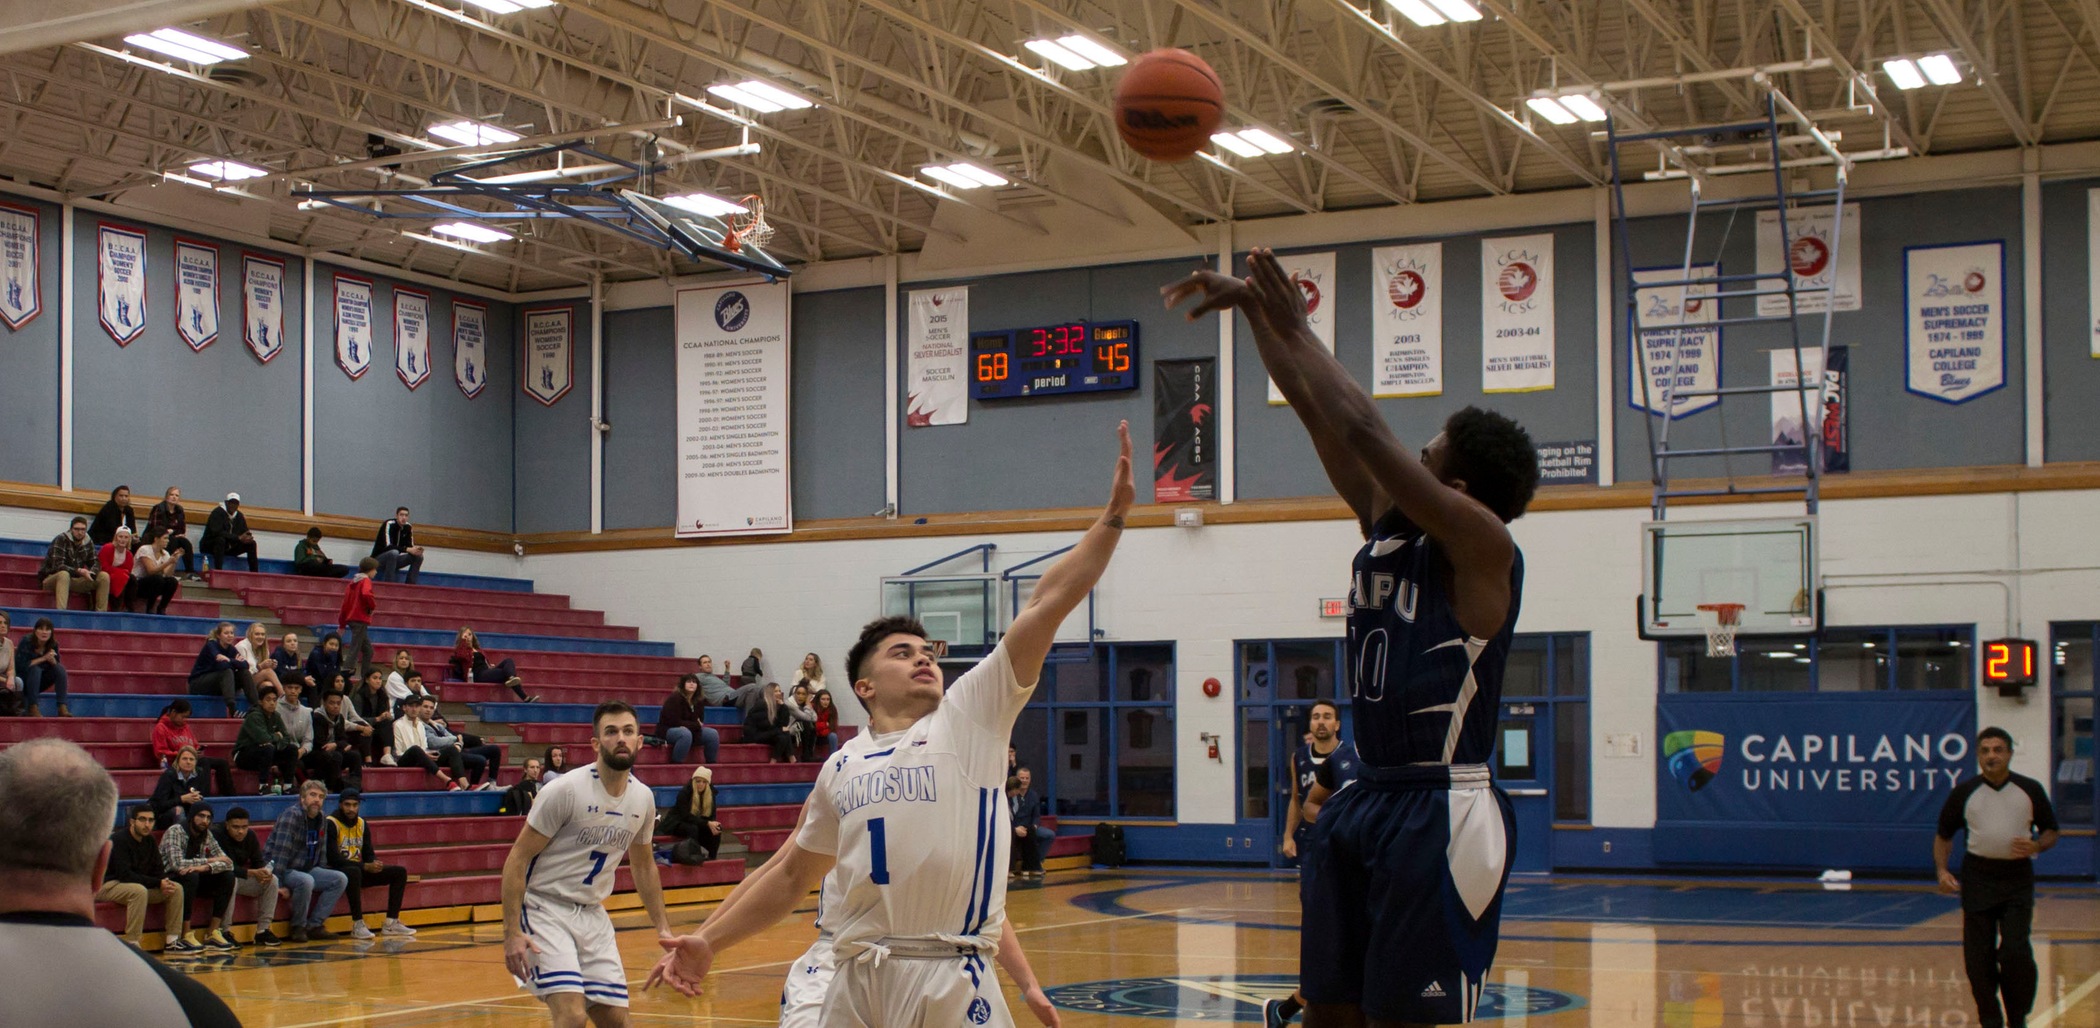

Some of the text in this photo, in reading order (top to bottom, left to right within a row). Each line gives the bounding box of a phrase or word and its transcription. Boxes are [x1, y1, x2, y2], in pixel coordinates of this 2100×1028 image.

[1497, 249, 1539, 266] CCAA
[1387, 258, 1427, 276] CCAA
[1497, 298, 1538, 314] ACSC
[1920, 304, 1990, 318] MEN'S SOCCER
[930, 314, 948, 324] 2015
[1388, 305, 1427, 322] ACSC
[1924, 317, 1988, 330] SUPREMACY
[926, 333, 951, 341] SOCCER
[1094, 327, 1129, 340] Guests
[1496, 327, 1540, 338] 2003-04
[1927, 332, 1951, 343] 1974
[1960, 330, 1984, 341] 1999
[704, 338, 738, 348] NATIONAL
[740, 335, 780, 344] CHAMPIONS
[922, 342, 953, 350] NATIONAL
[1032, 325, 1085, 357] 3:32
[1394, 334, 1421, 345] 2003
[914, 348, 963, 359] SILVER MEDALIST
[1098, 343, 1130, 372] 45
[1404, 355, 1430, 363] SINGLES
[1489, 354, 1548, 364] MEN'S VOLLEYBALL
[1650, 348, 1702, 360] 1974 1999
[1929, 347, 1981, 359] CAPILANO
[978, 352, 1008, 381] 68
[1385, 362, 1430, 372] CHAMPION
[1486, 360, 1552, 372] SILVER MEDALIST
[1933, 360, 1976, 372] COLLEGE
[922, 374, 955, 382] MASCULIN
[1034, 374, 1066, 390] period
[1564, 447, 1576, 455] on
[1576, 444, 1592, 454] the
[1573, 456, 1592, 466] Rim
[1541, 467, 1587, 478] Prohibited
[1988, 644, 2031, 678] 21
[1741, 733, 1968, 762] CAPILANO
[1742, 768, 1963, 792] UNIVERSITY
[867, 817, 890, 885] 1
[582, 850, 608, 885] 7
